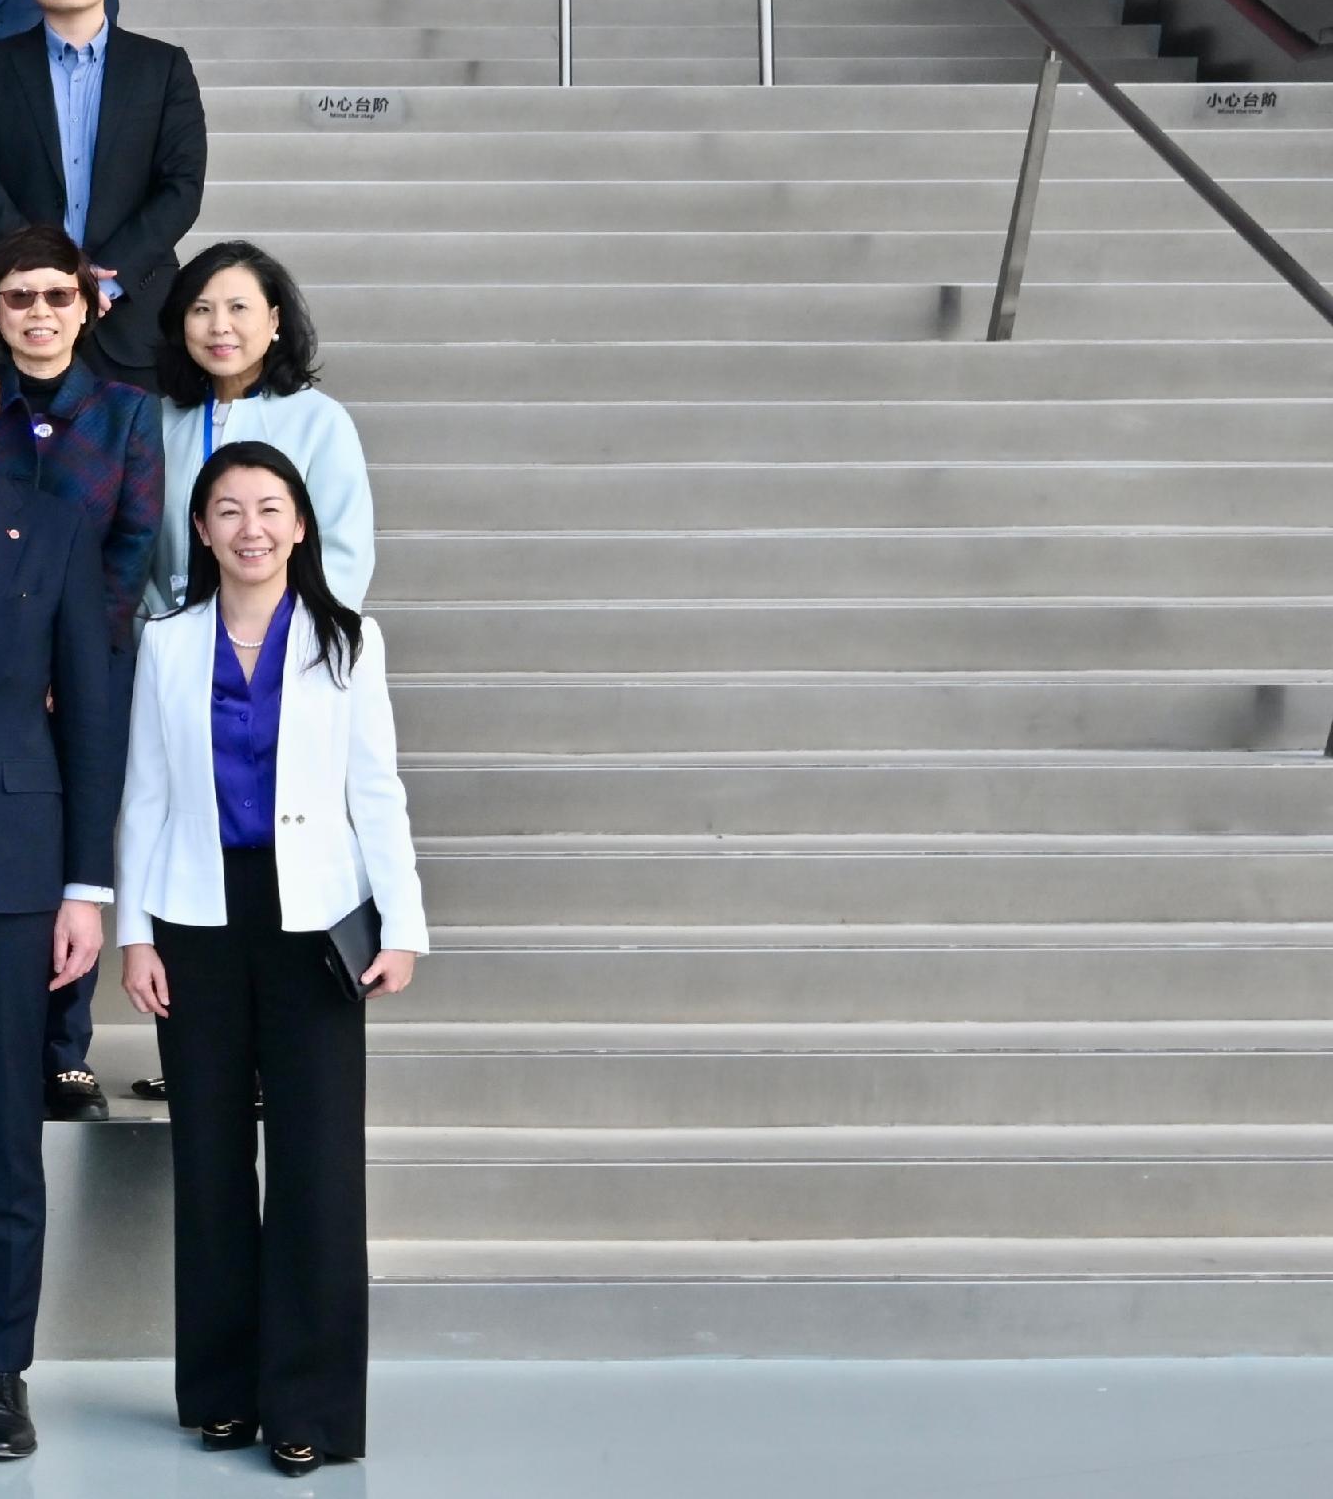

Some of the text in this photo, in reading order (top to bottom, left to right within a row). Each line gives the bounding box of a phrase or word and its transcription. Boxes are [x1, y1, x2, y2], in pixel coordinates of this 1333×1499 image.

[318, 96, 389, 113] 小心台阶
[1206, 91, 1277, 108] 小心台阶
